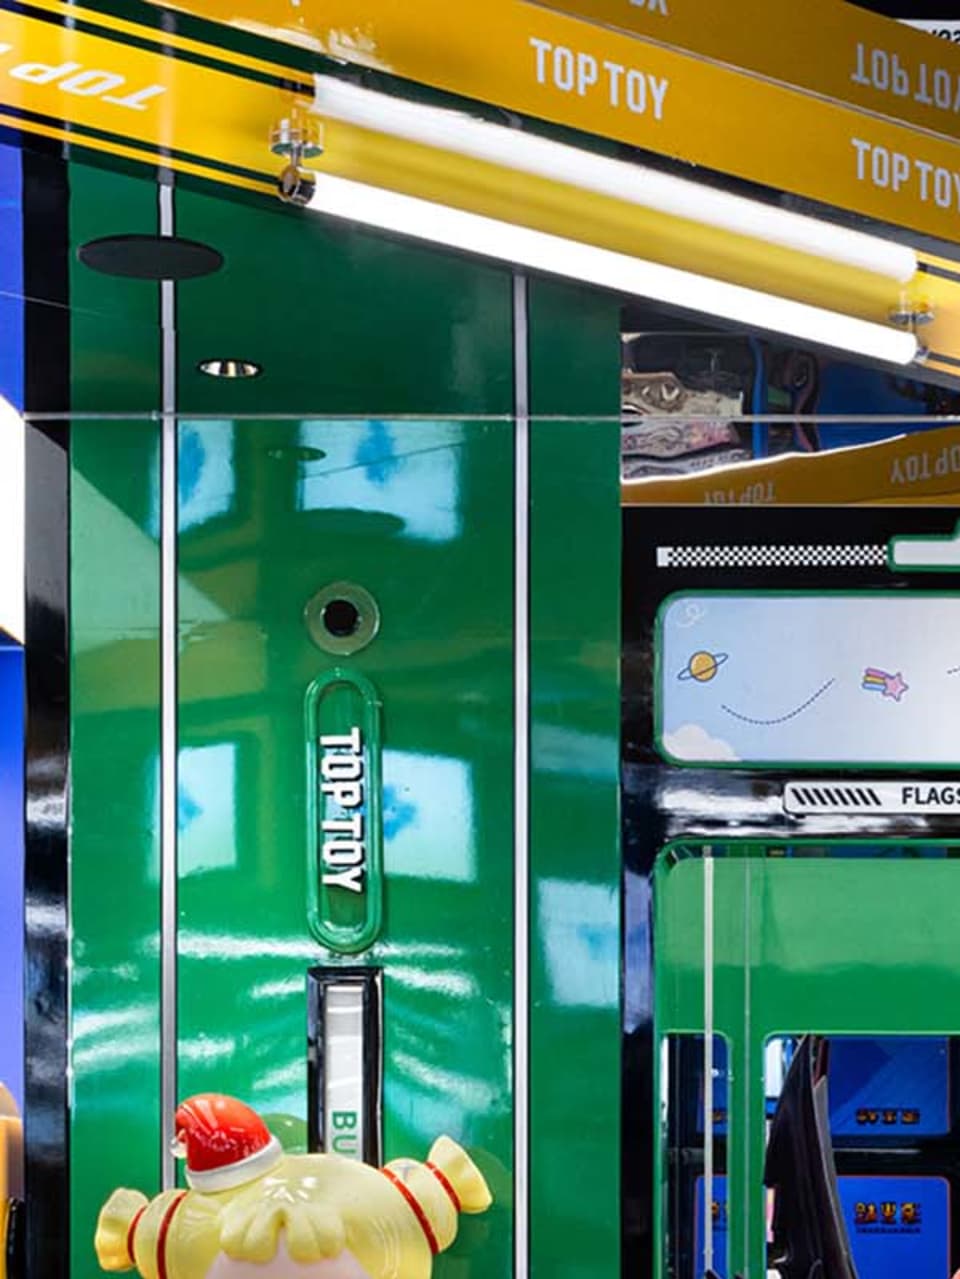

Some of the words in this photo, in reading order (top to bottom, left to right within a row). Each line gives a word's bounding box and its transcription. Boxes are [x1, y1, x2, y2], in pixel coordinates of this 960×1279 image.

[529, 37, 598, 96] TOP
[603, 60, 669, 120] TOY
[851, 138, 910, 192] TOP
[319, 726, 363, 809] TOP
[321, 813, 365, 893] TOY
[332, 1111, 357, 1153] BU
